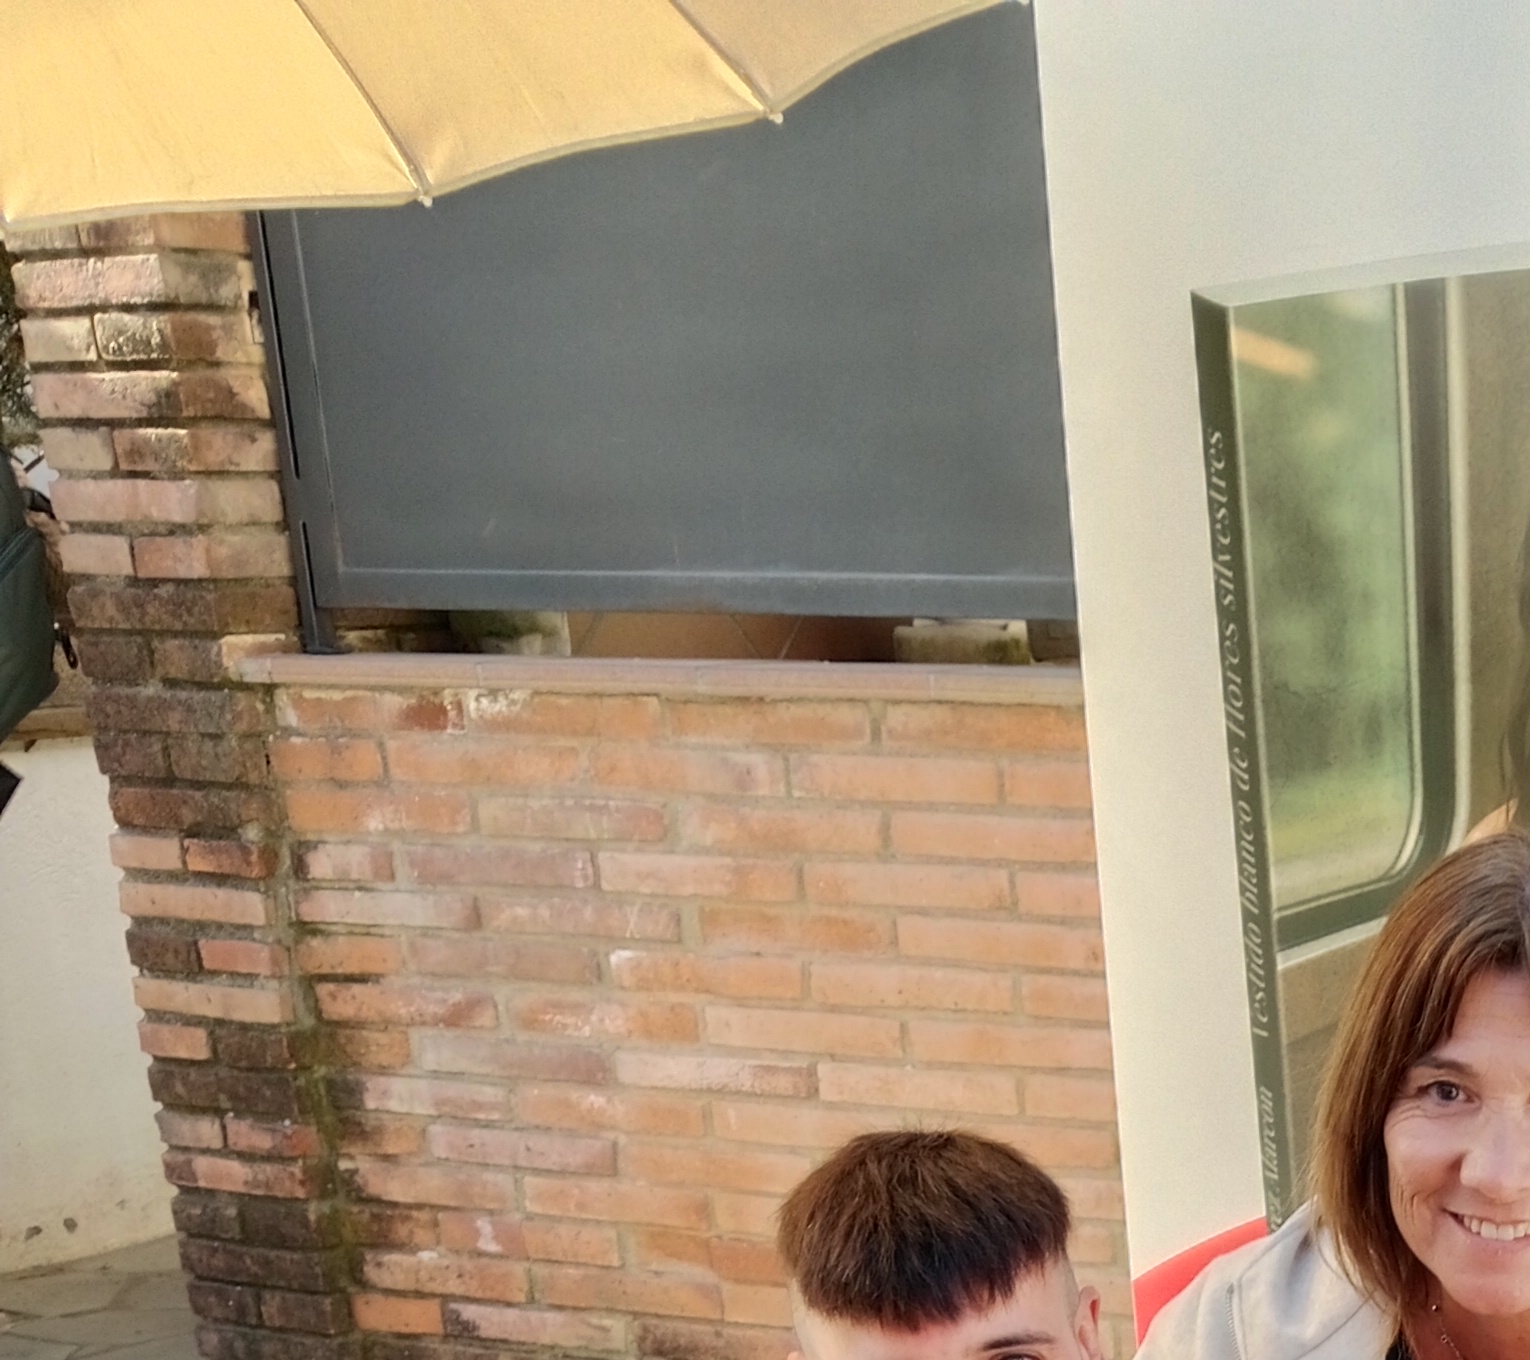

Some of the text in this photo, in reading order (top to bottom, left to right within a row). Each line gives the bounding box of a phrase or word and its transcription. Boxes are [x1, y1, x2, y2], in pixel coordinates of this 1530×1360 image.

[1207, 427, 1236, 610] silvestres
[1229, 745, 1251, 791] de
[1234, 800, 1260, 915] blanco
